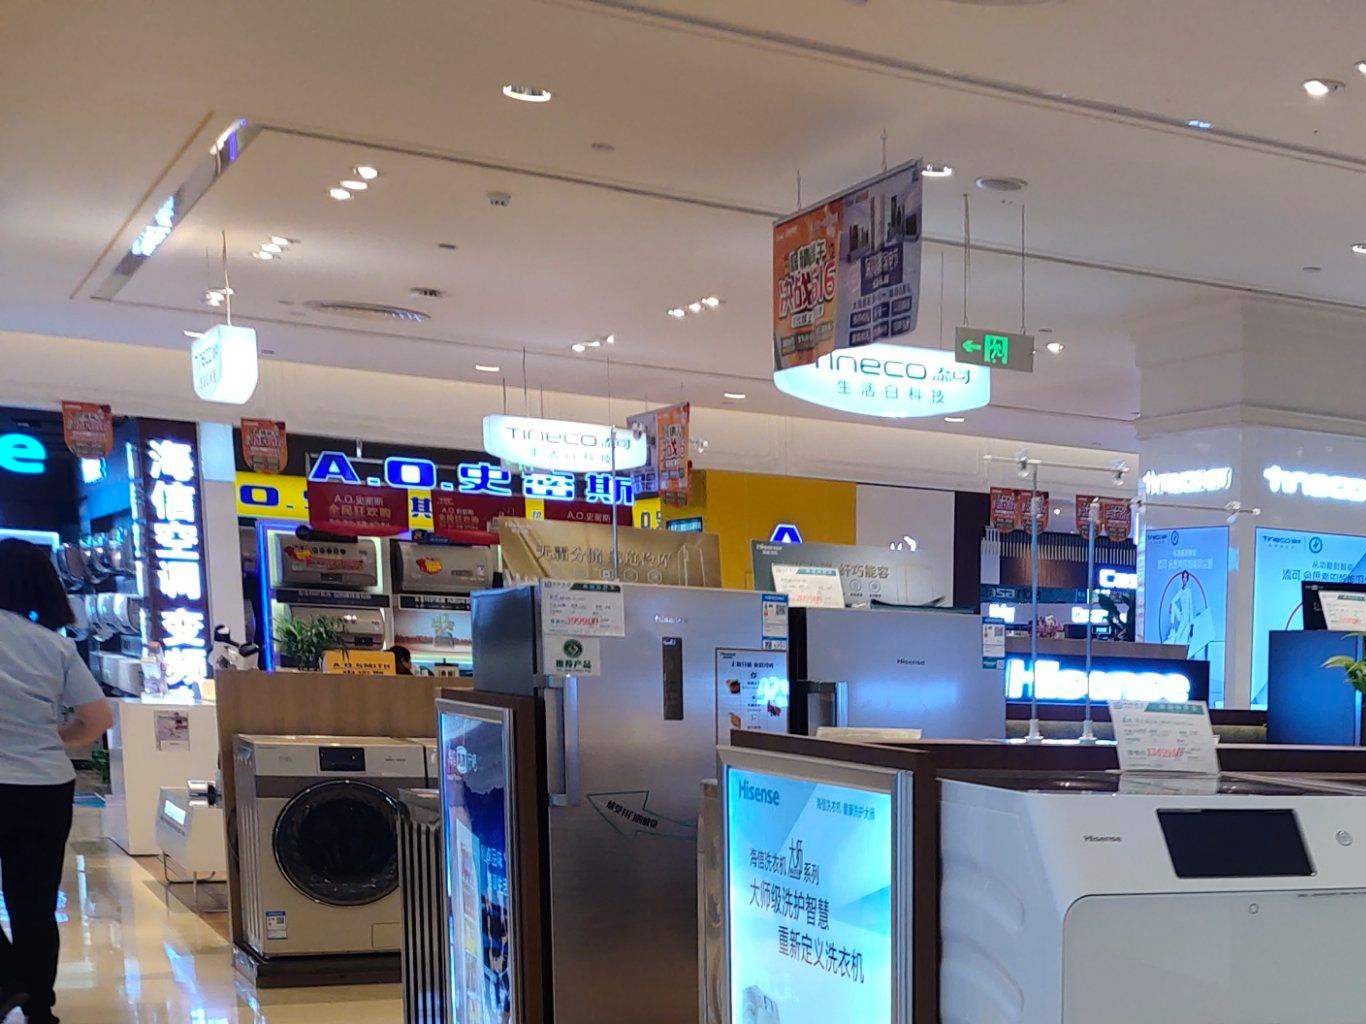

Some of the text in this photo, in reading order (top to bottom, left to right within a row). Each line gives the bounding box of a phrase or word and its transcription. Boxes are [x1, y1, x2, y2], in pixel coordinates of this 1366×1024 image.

[148, 438, 201, 599] 海信空调
[738, 779, 780, 806] Hisense
[749, 877, 830, 930] 大师级洗护智慧
[777, 925, 865, 984] 重新定义洗衣机
